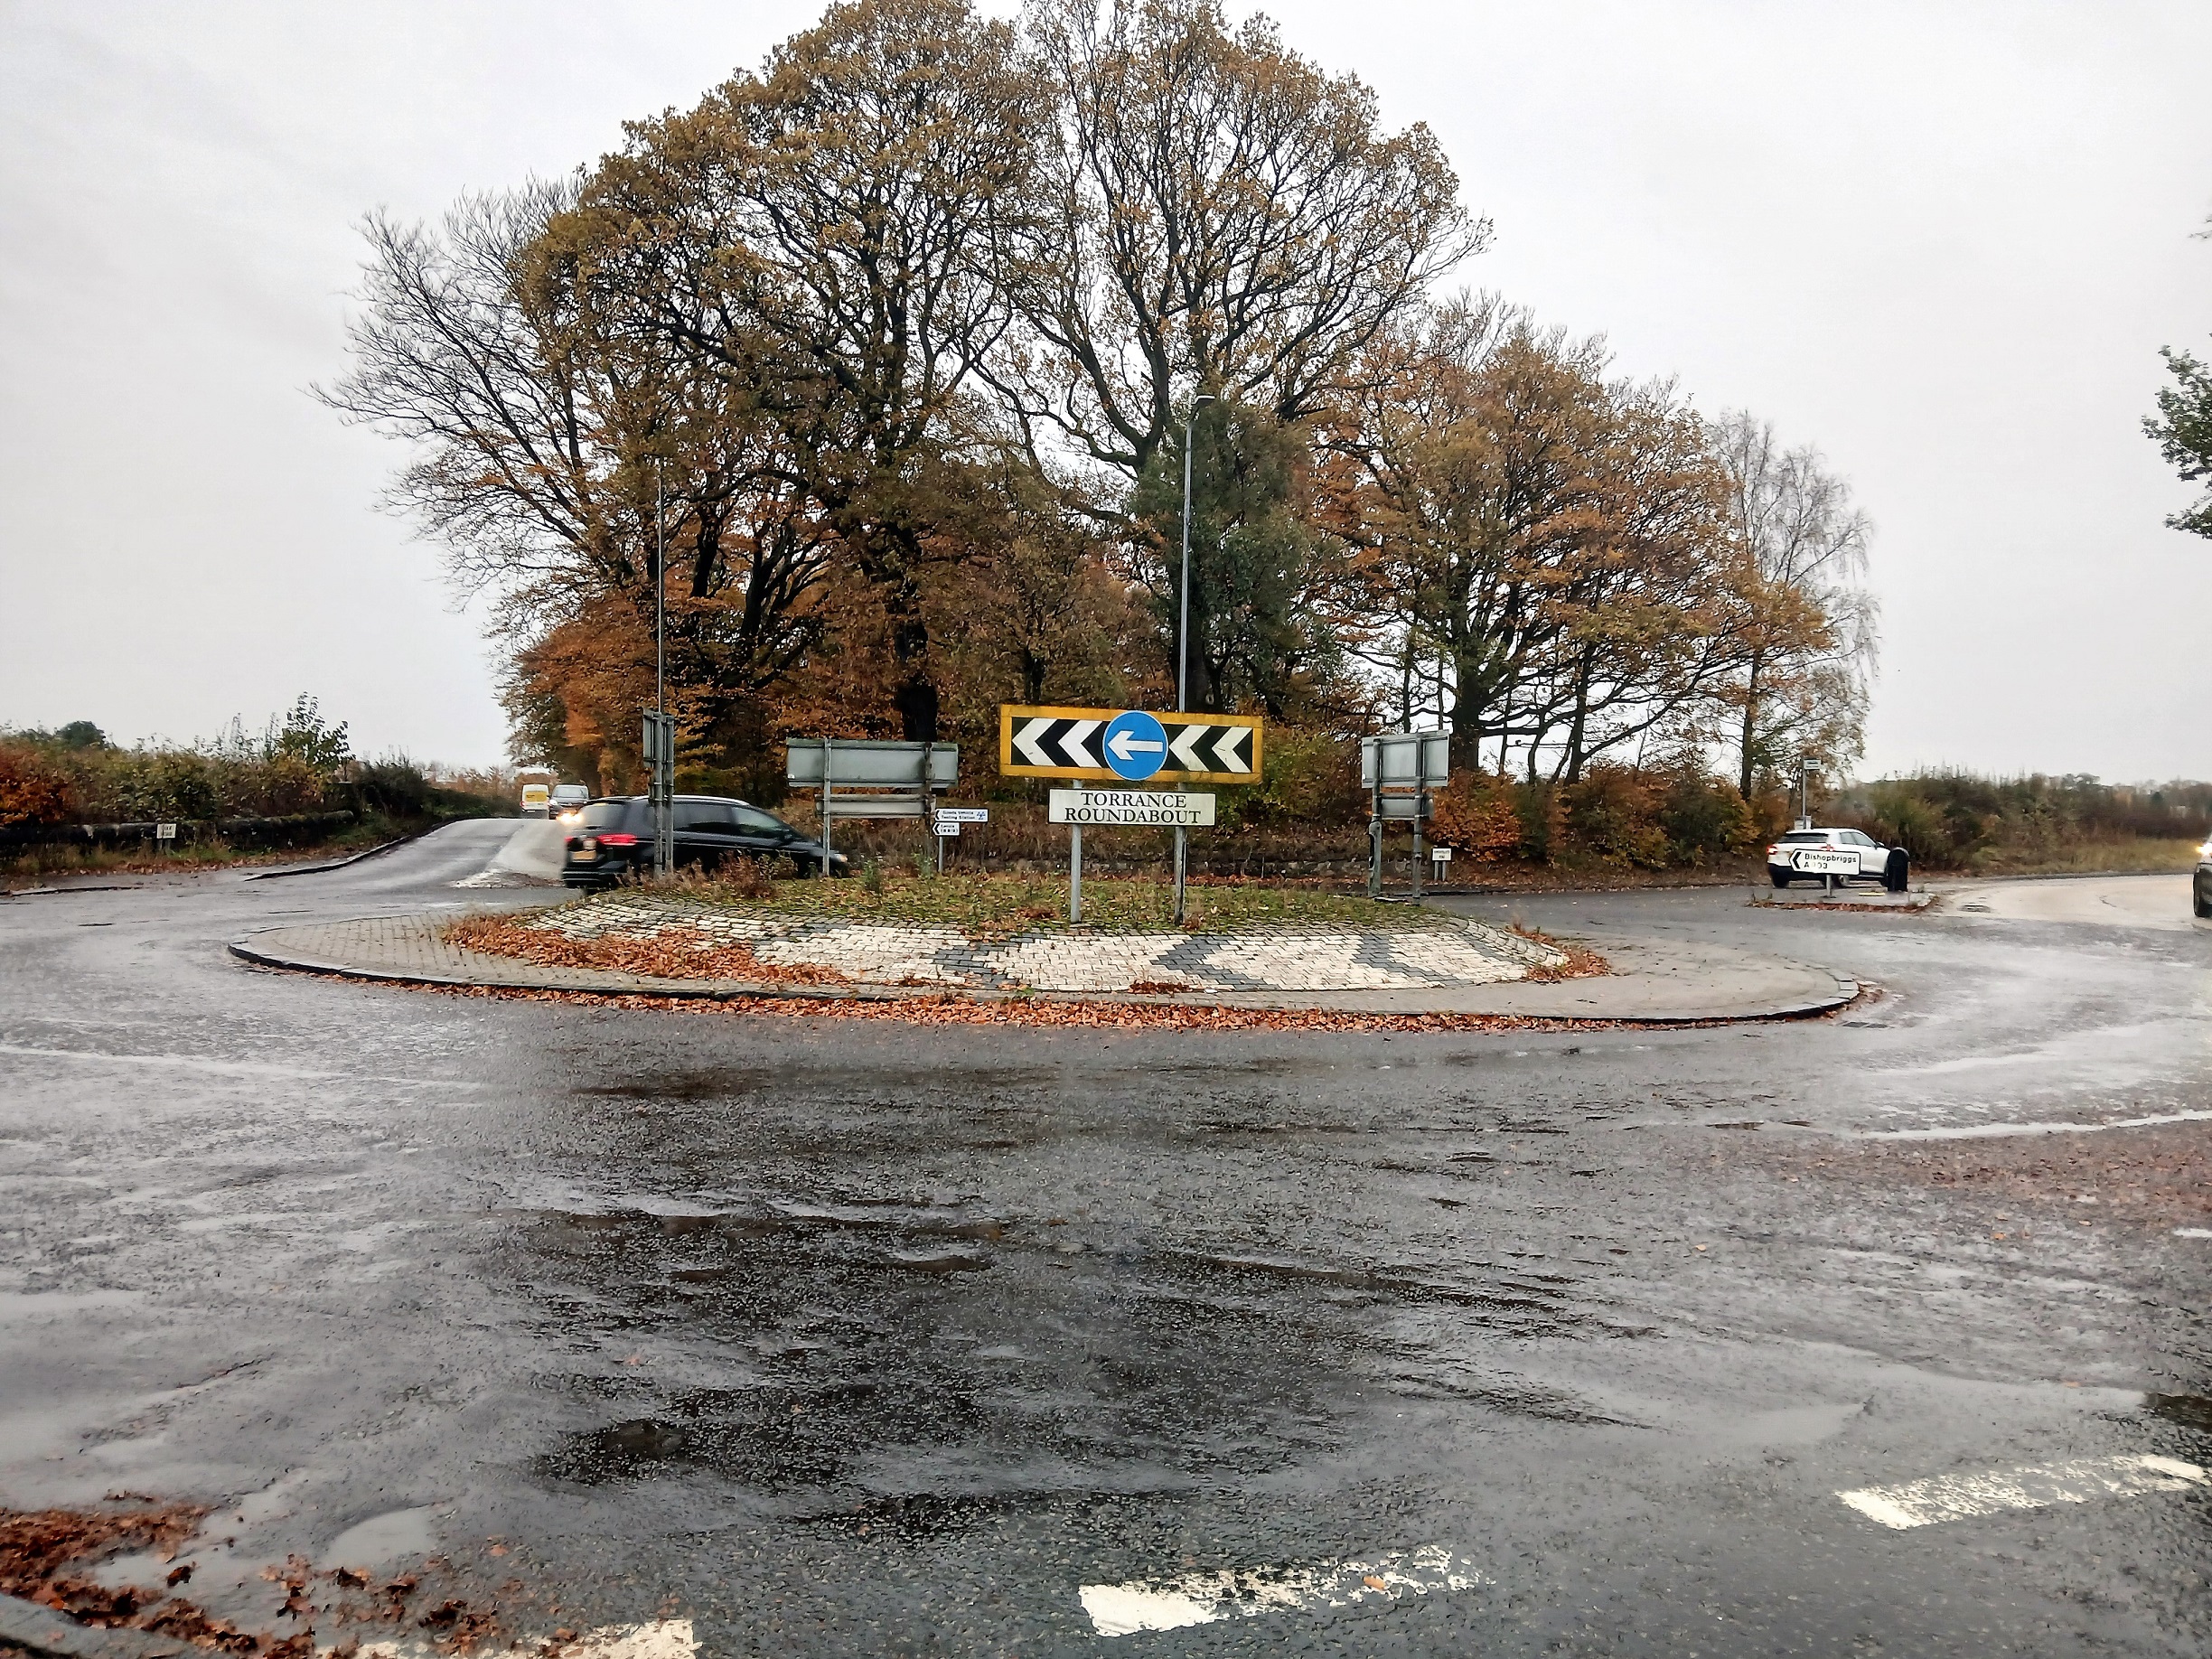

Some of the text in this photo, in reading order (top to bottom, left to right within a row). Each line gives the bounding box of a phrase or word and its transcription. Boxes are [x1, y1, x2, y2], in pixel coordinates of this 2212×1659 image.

[1081, 792, 1186, 808] TORRANCE
[1064, 807, 1201, 824] ROUNDABOUT
[1804, 853, 1857, 863] Bishopbriggs
